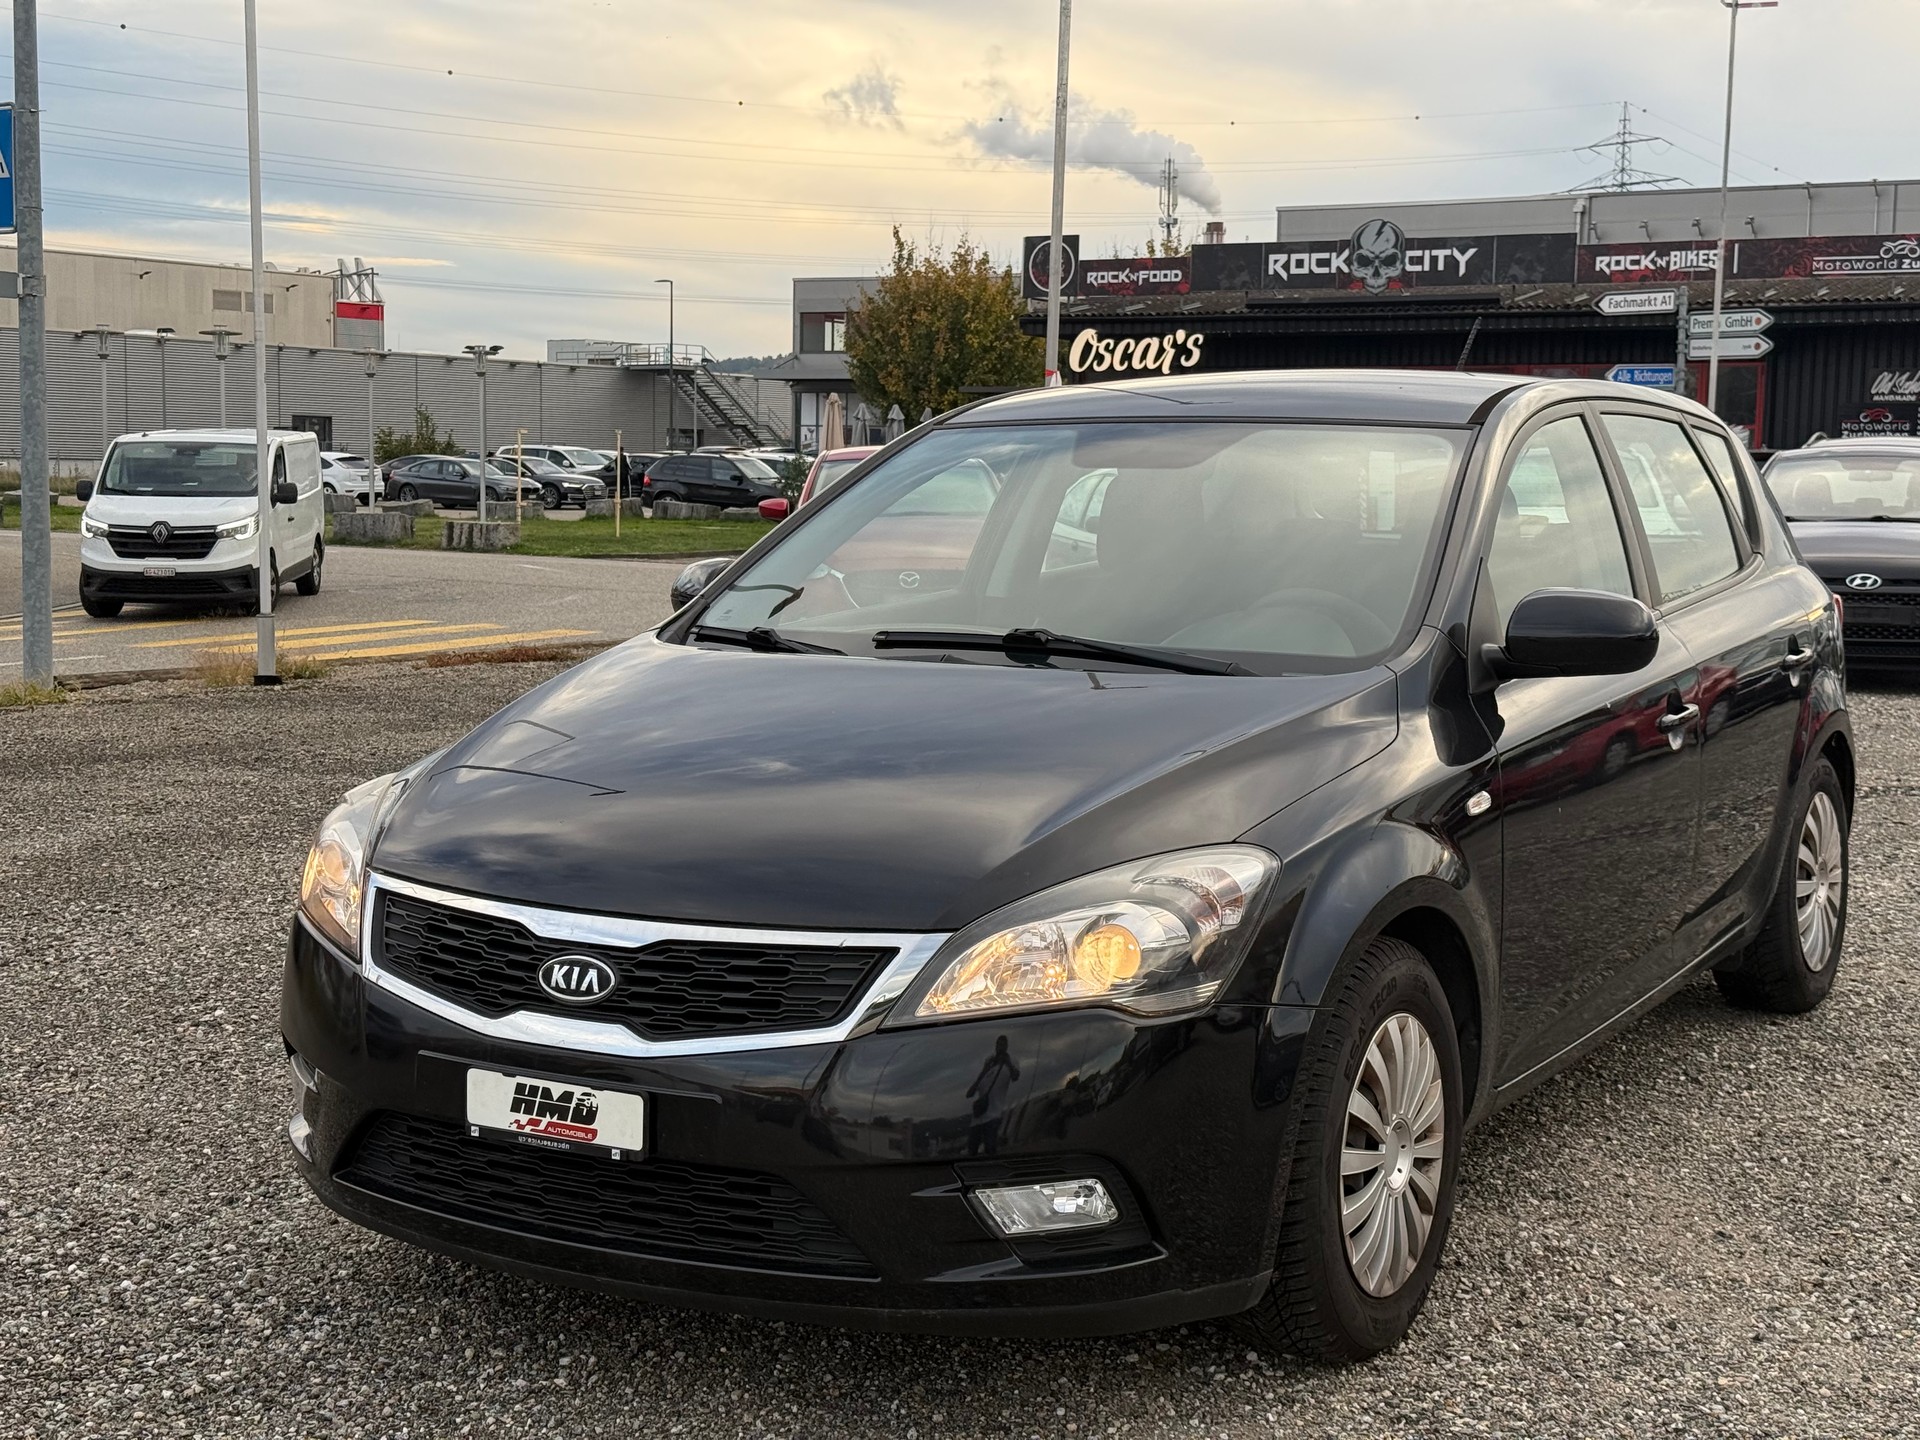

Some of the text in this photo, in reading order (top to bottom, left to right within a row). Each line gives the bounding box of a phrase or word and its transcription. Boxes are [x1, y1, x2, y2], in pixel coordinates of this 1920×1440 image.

[1268, 247, 1479, 282] ROCK CITY
[1812, 258, 1897, 271] MotoWorld
[1608, 295, 1672, 309] Fachmarkt A1
[1725, 315, 1753, 328] GmbH
[1069, 328, 1204, 375] Oscar's
[1617, 369, 1672, 385] Alle Richtungen
[1841, 422, 1910, 431] MotoWorld
[550, 964, 599, 994] KIA
[546, 1126, 594, 1140] AUTOMOBILE
